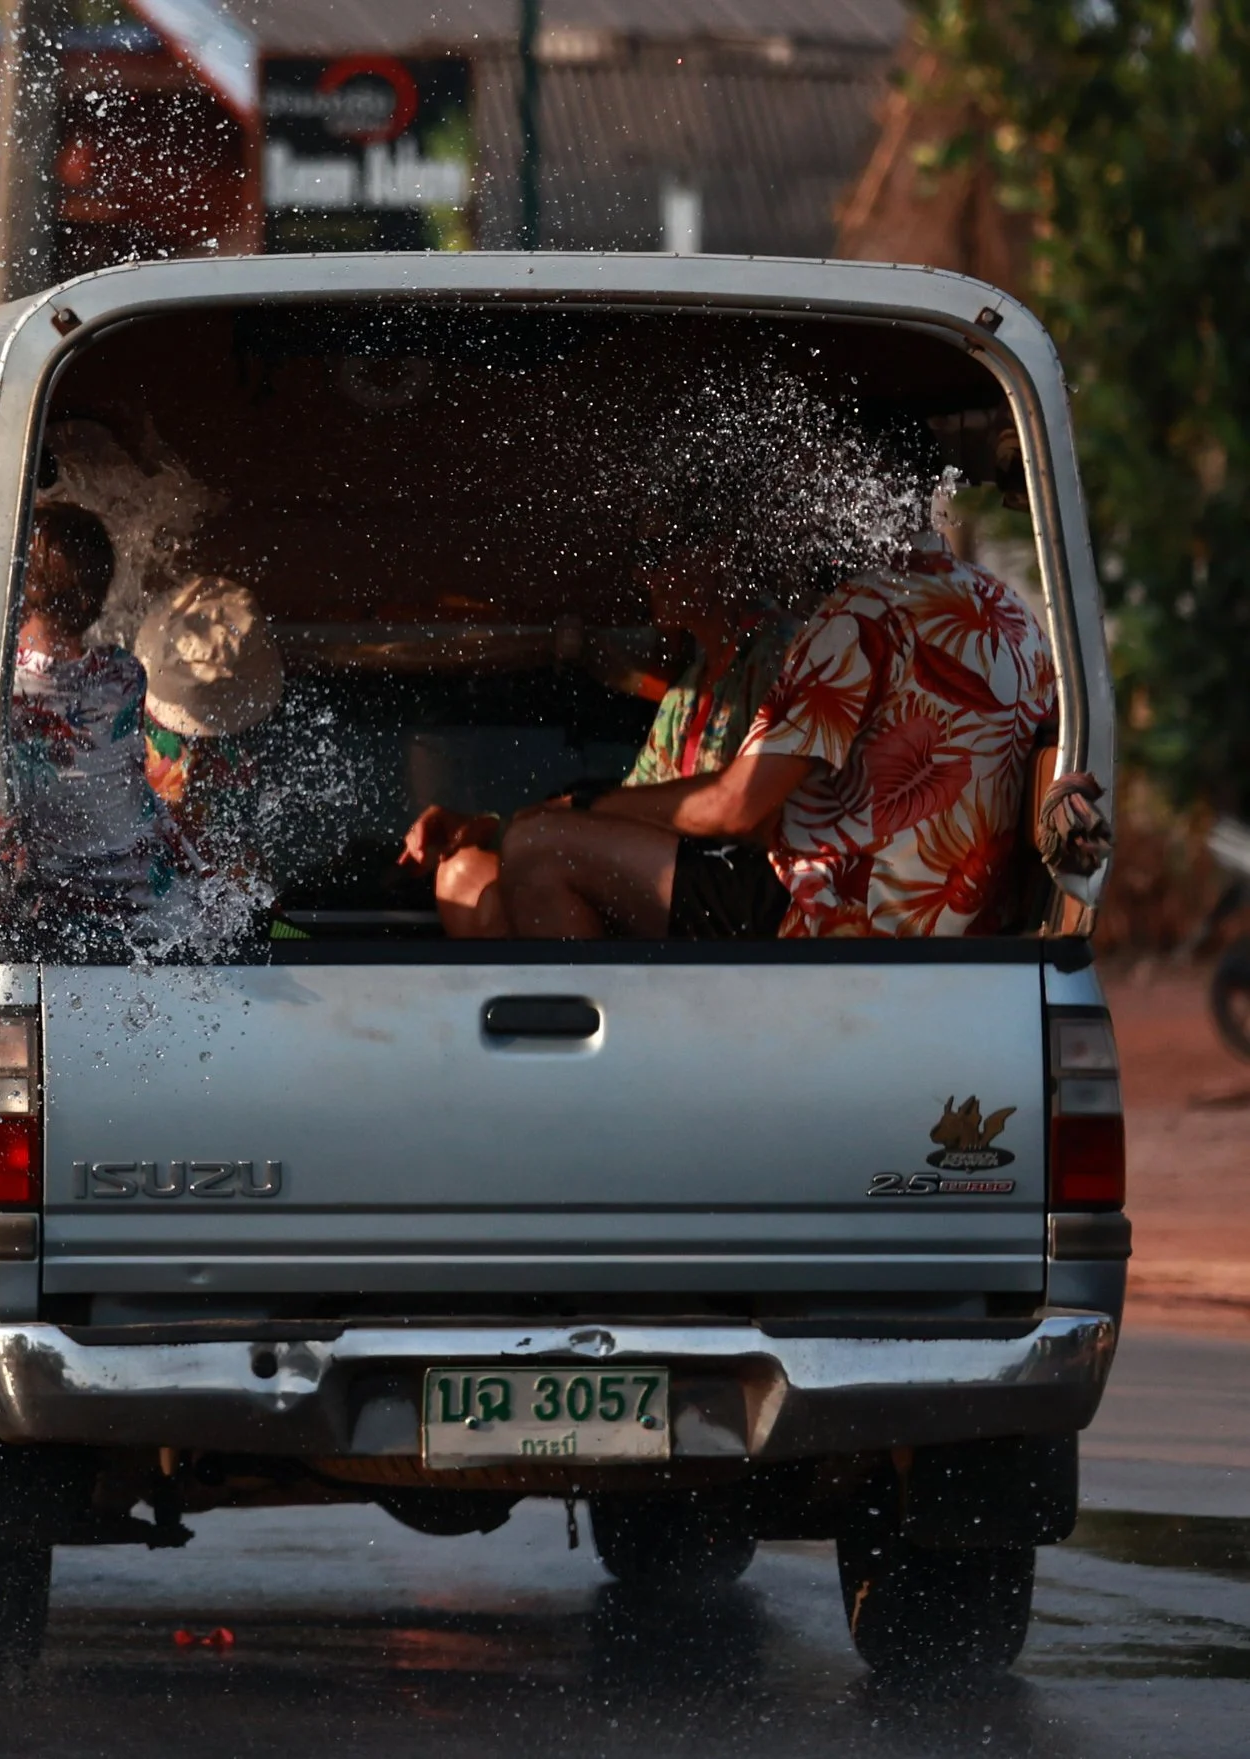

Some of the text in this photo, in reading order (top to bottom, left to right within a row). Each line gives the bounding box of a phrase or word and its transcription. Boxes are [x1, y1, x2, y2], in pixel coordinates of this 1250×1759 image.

[72, 1160, 283, 1199] ISUZU
[867, 1173, 939, 1196] 2.5
[438, 1376, 660, 1422] บฉ 3057
